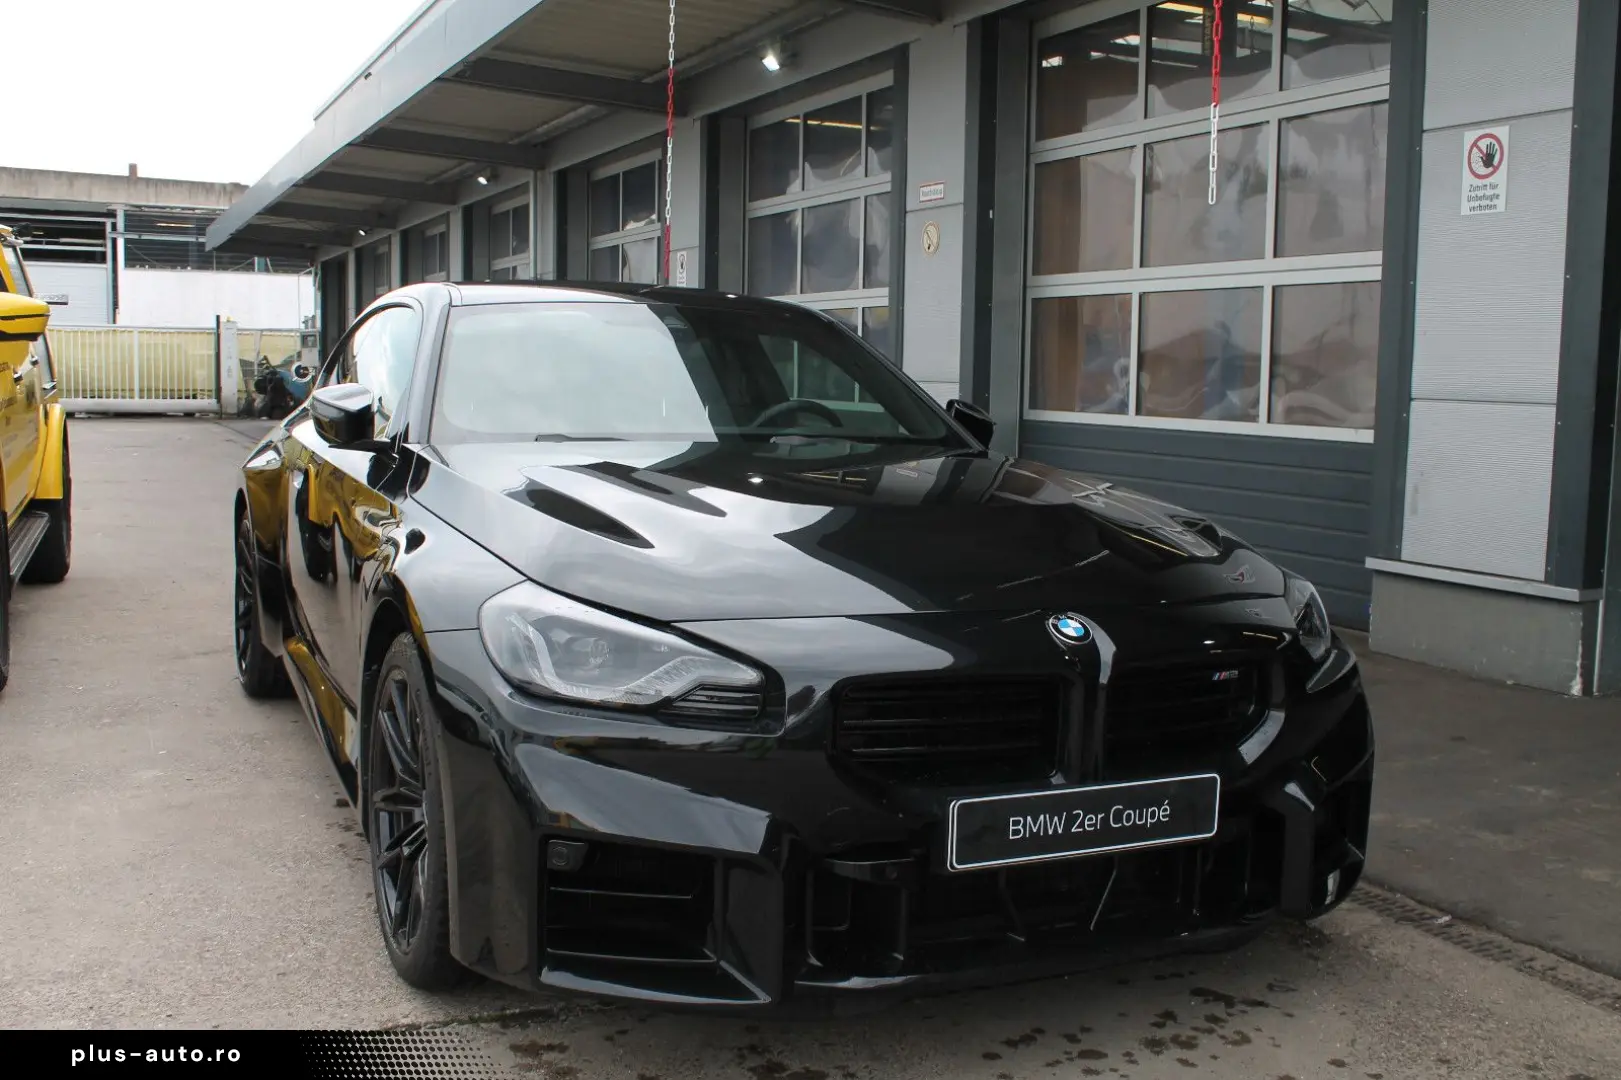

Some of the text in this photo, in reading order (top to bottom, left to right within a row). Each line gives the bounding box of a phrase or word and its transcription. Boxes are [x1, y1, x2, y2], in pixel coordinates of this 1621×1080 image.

[1468, 182, 1499, 193] Zutritt für
[1467, 192, 1500, 203] Unbefugte
[1469, 203, 1497, 212] verboten
[1009, 799, 1170, 840] BMW 2er Coupé
